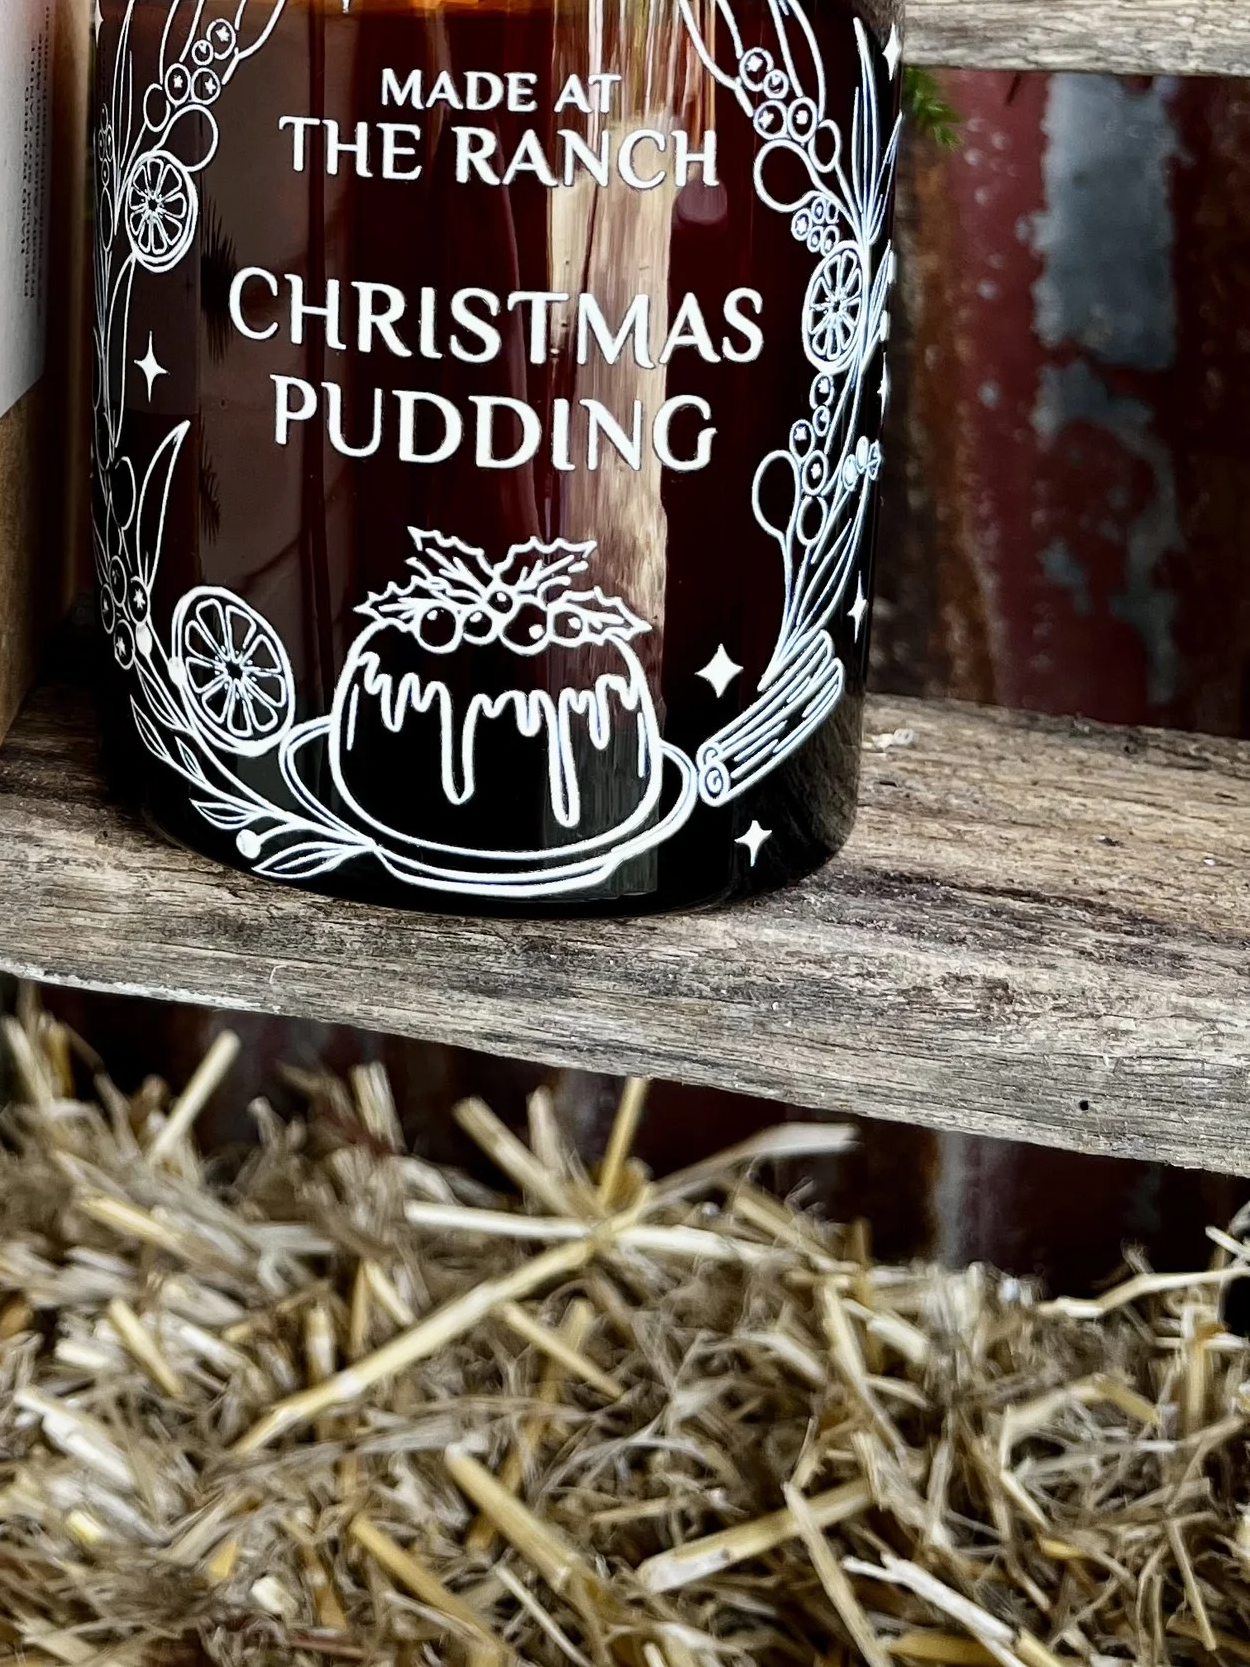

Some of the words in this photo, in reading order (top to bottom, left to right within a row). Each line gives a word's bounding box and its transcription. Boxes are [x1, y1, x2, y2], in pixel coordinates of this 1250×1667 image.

[382, 69, 537, 112] MADE
[554, 73, 622, 113] AT
[279, 116, 422, 180] THE
[452, 125, 720, 189] RANCH
[230, 265, 764, 370] CHRISTMAS
[270, 374, 718, 472] PUDDING
